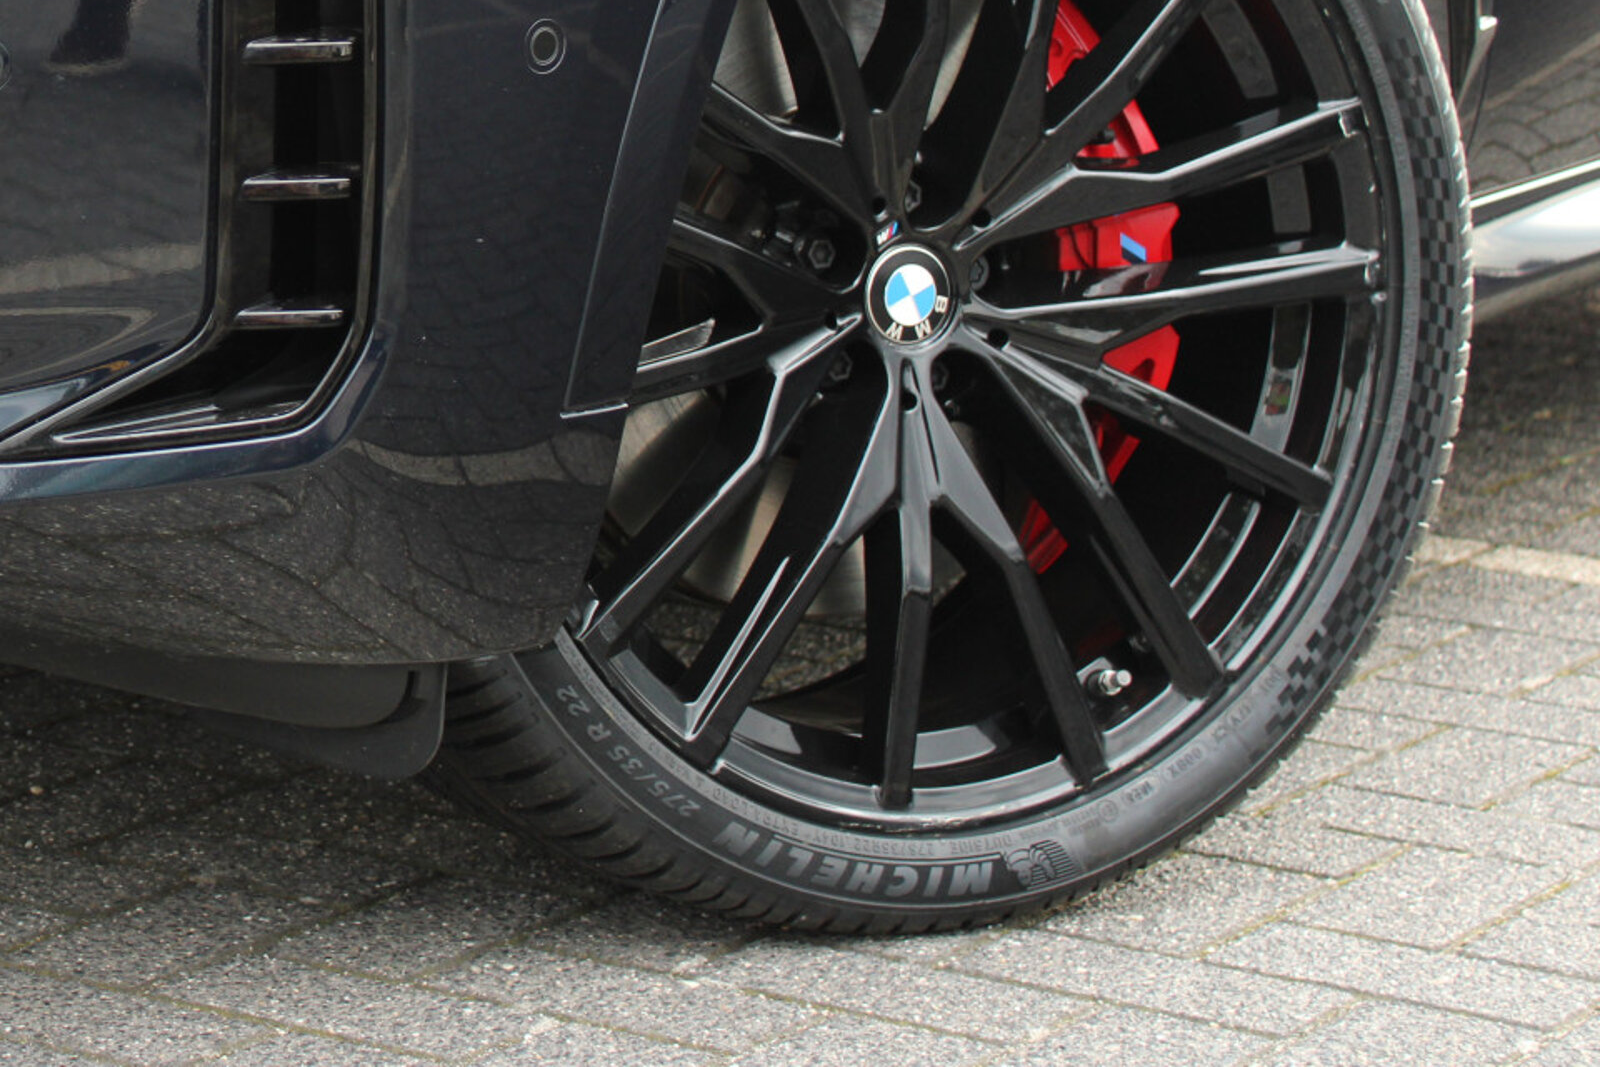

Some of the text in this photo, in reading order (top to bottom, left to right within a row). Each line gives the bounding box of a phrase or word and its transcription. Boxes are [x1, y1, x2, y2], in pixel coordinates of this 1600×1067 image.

[886, 295, 949, 340] BMW
[556, 684, 591, 717] 22
[586, 721, 613, 744] R
[609, 745, 700, 818] 275/35
[714, 820, 995, 898] MICHELIN
